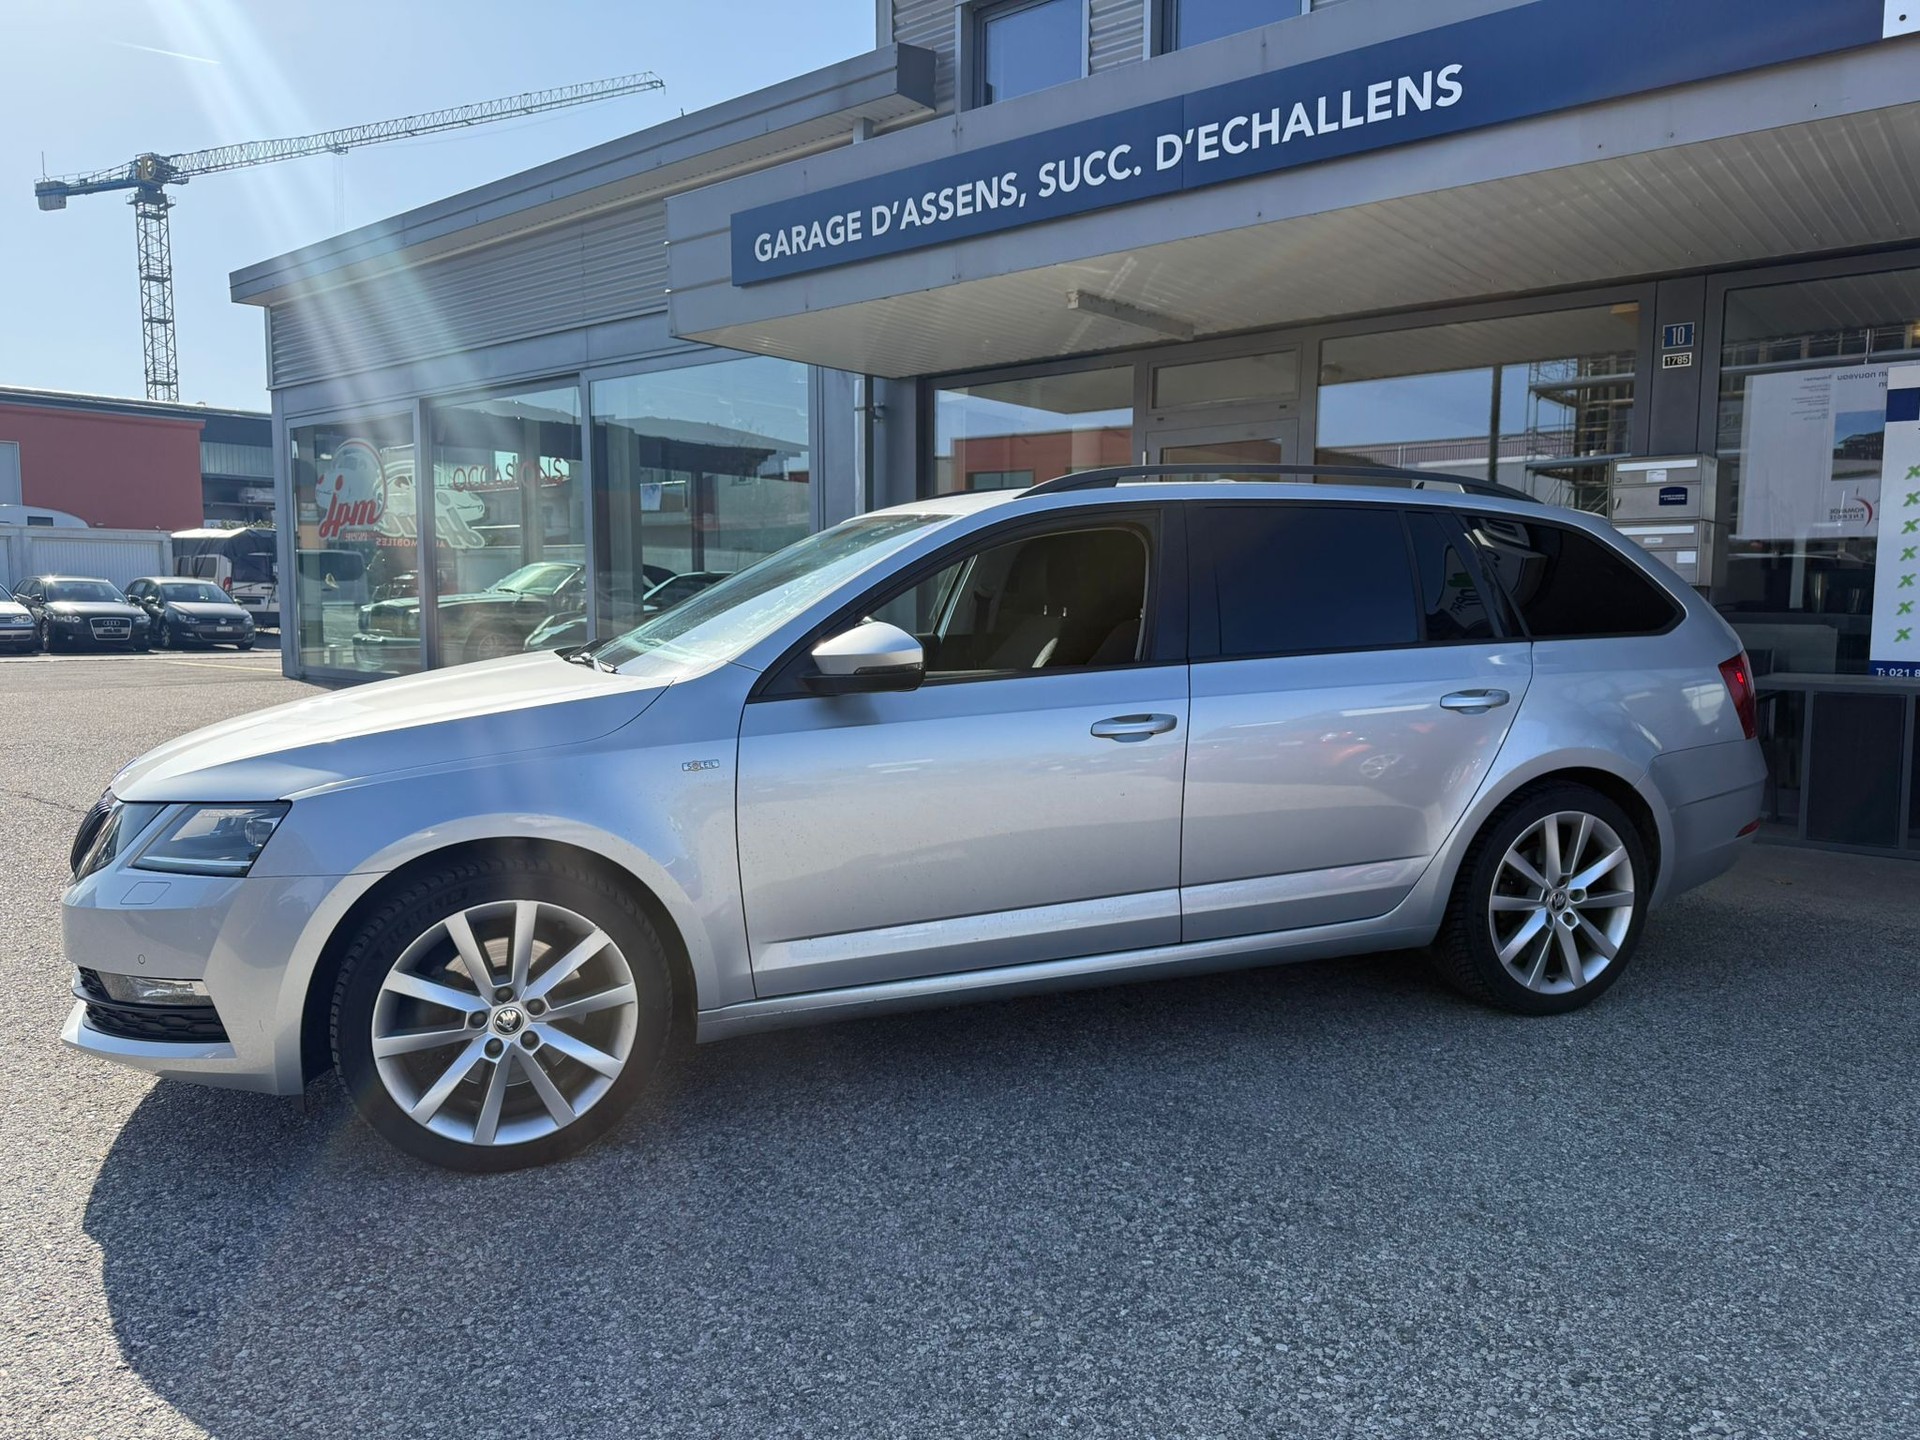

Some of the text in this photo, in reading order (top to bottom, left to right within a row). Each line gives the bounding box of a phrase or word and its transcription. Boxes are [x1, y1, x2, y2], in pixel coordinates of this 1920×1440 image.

[754, 63, 1463, 262] GARAGE D'ASSENS, SUCC. D'ECHALLENS
[1672, 326, 1685, 345] 10
[1666, 355, 1689, 366] 1785
[453, 457, 564, 492] OCCASIONS
[319, 474, 377, 538] jpm
[1876, 667, 1886, 676] T:
[1889, 668, 1910, 677] 021
